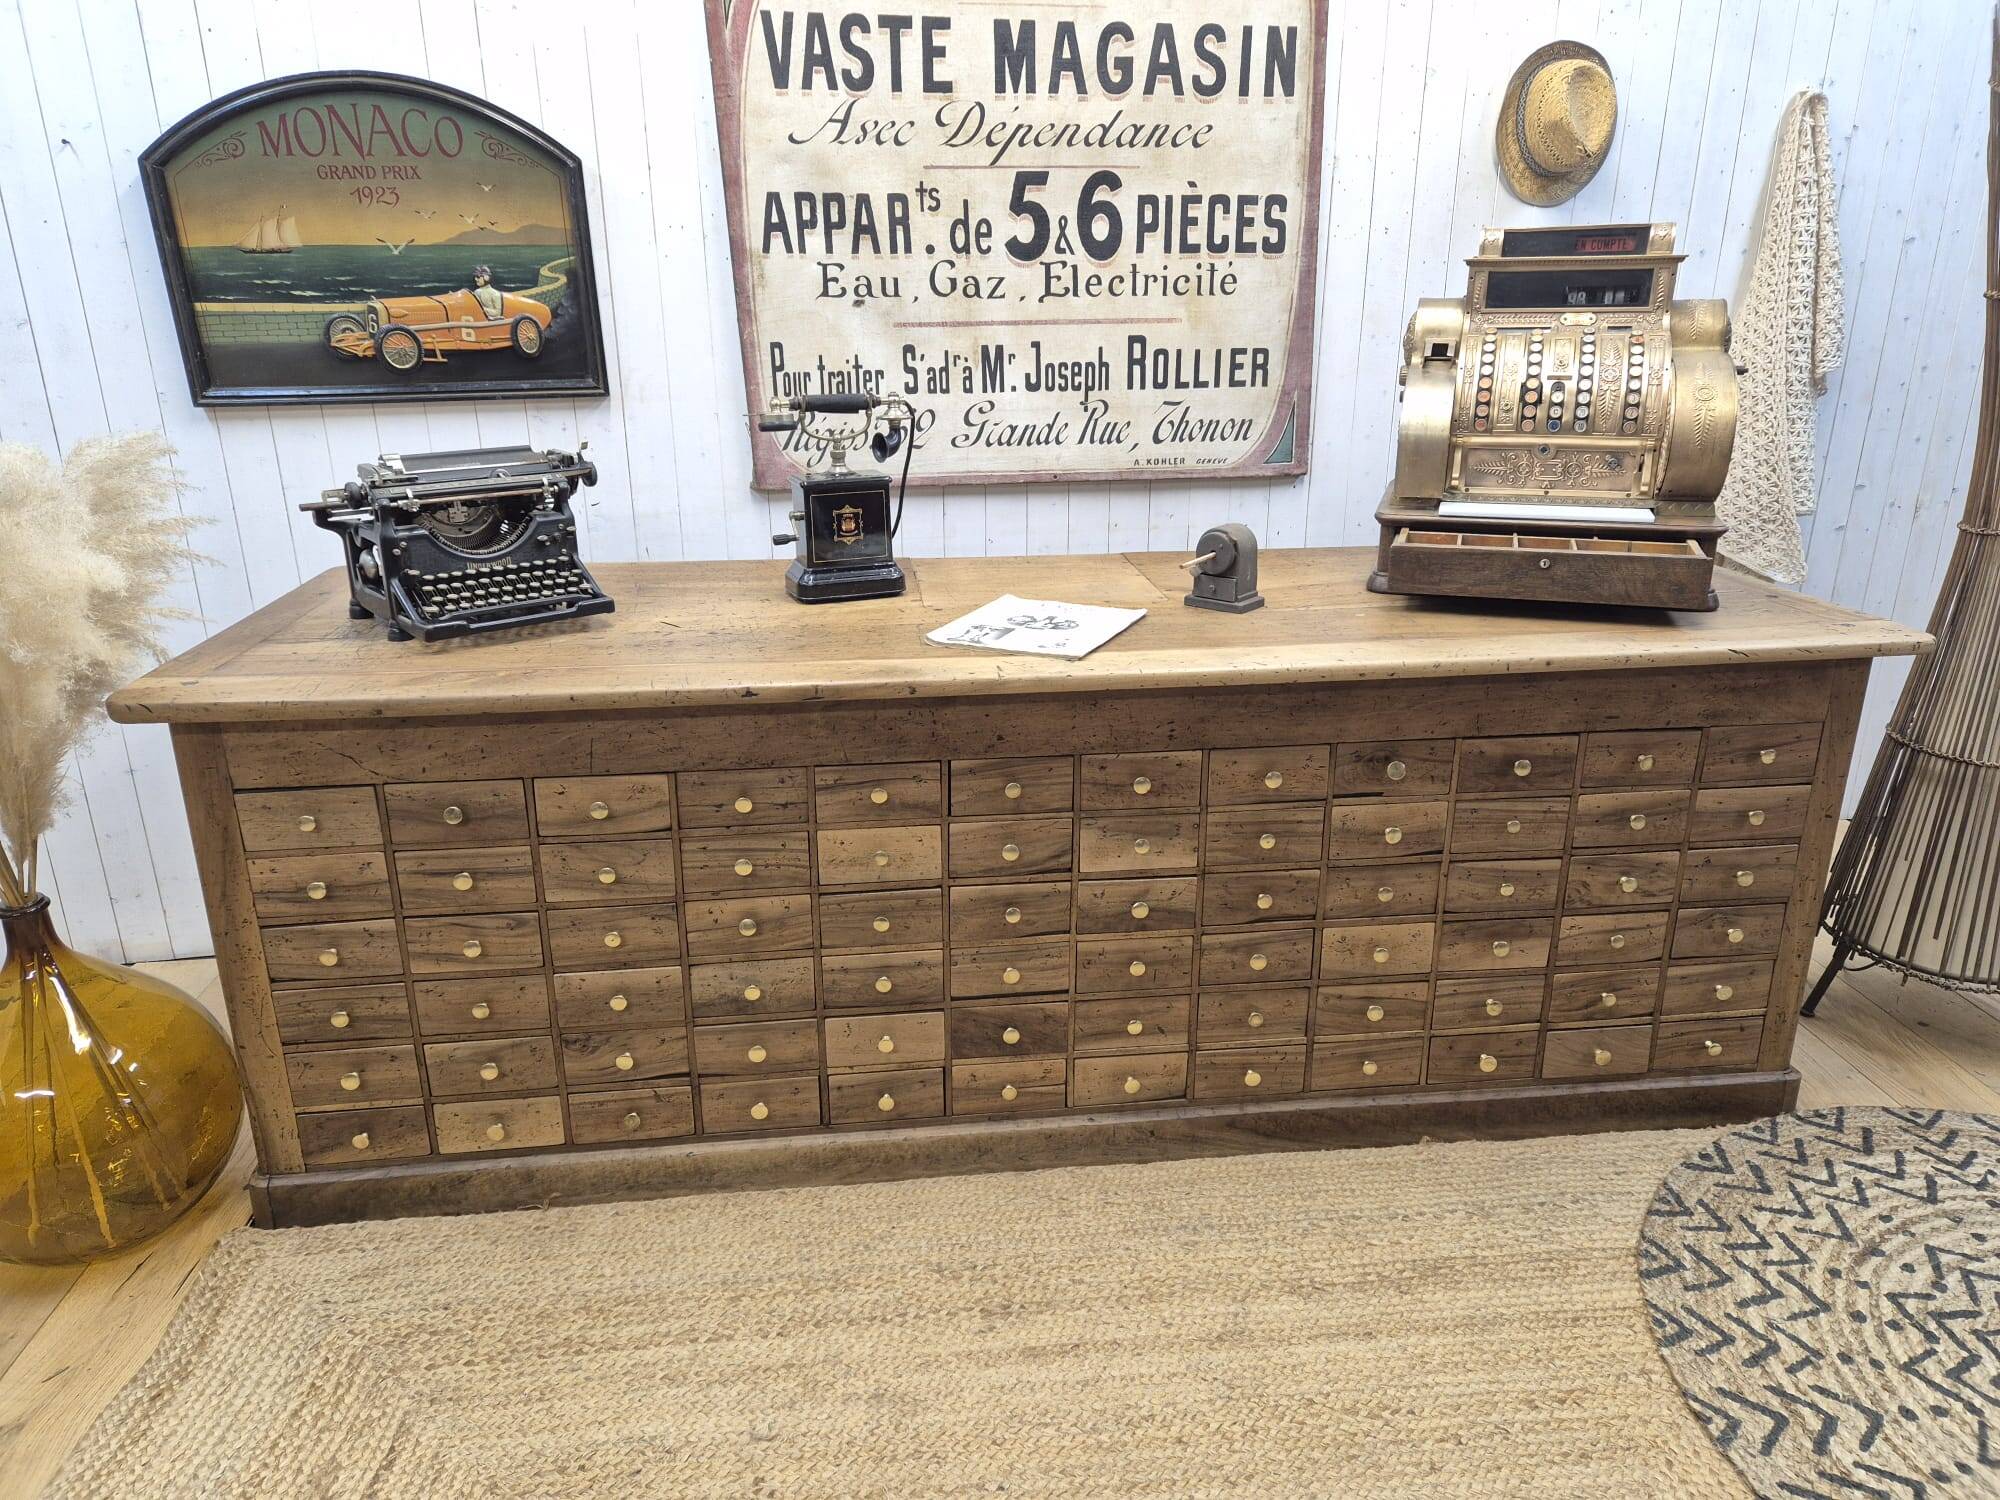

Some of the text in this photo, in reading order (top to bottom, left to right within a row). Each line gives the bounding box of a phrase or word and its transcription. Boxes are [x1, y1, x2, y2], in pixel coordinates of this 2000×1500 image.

[760, 10, 1298, 99] VASTE MAGASIN
[257, 103, 464, 160] MONACO
[935, 99, 1214, 167] Dépendance
[316, 164, 422, 181] GRAND PRIX
[350, 185, 400, 209] 1923
[949, 198, 993, 255] de
[1135, 180, 1288, 254] PIÈCES
[1037, 260, 1238, 303] Electricité
[769, 341, 812, 400] Pour
[817, 353, 885, 396] traiter
[1024, 340, 1110, 412] Joseph
[1126, 334, 1270, 390] ROLLIER
[950, 399, 1069, 448] Grande
[1152, 398, 1254, 445] Thonon
